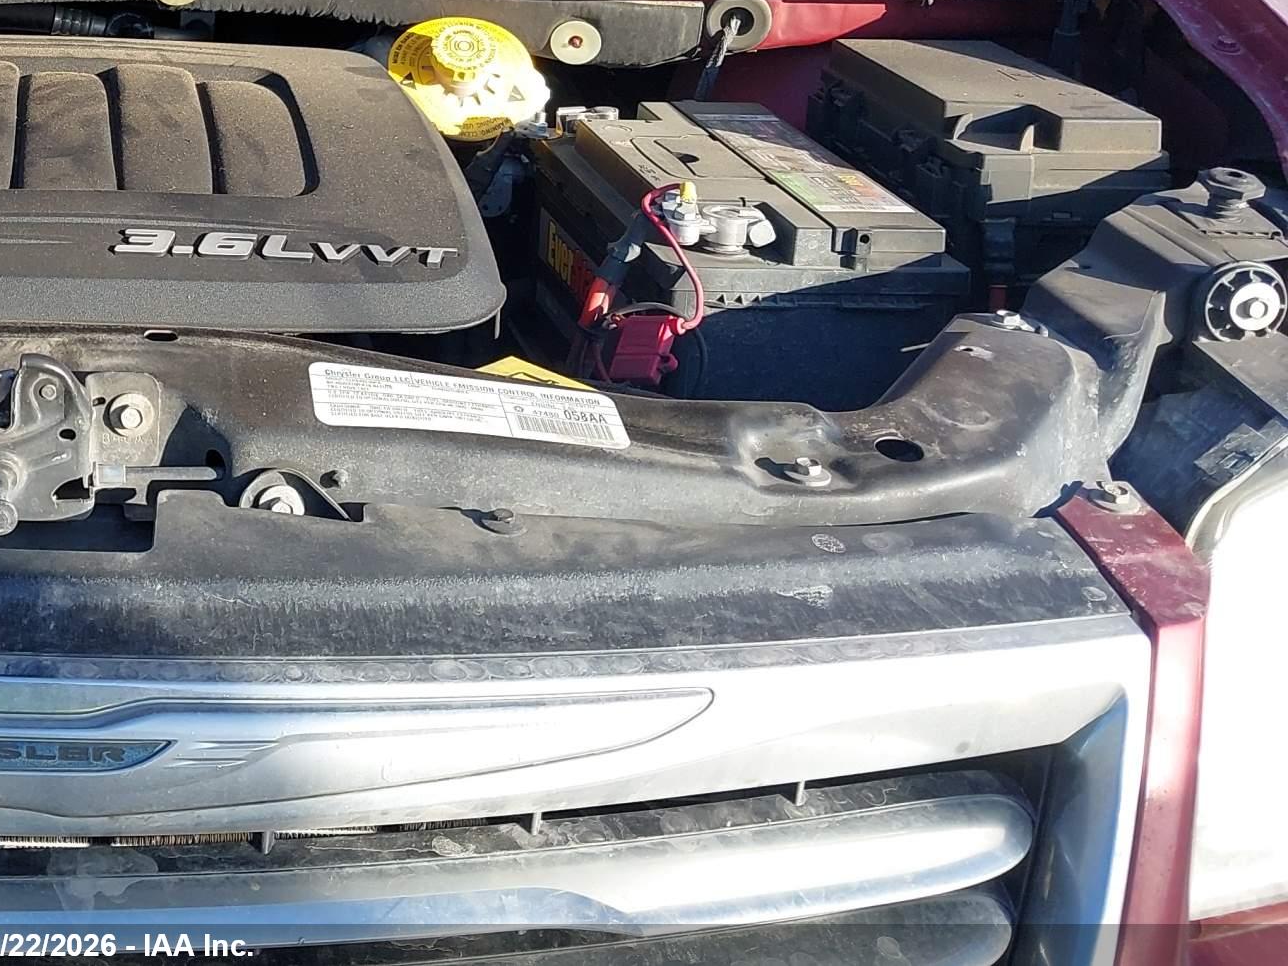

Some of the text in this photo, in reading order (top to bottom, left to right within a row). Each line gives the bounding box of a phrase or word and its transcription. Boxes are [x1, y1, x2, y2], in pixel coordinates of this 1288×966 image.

[324, 369, 361, 379] Chrysler
[364, 372, 391, 382] Group
[415, 378, 450, 388] VEHICLE
[452, 382, 495, 393] EMISSION
[497, 388, 536, 397] CONTROL
[540, 393, 600, 405] INFORMATION
